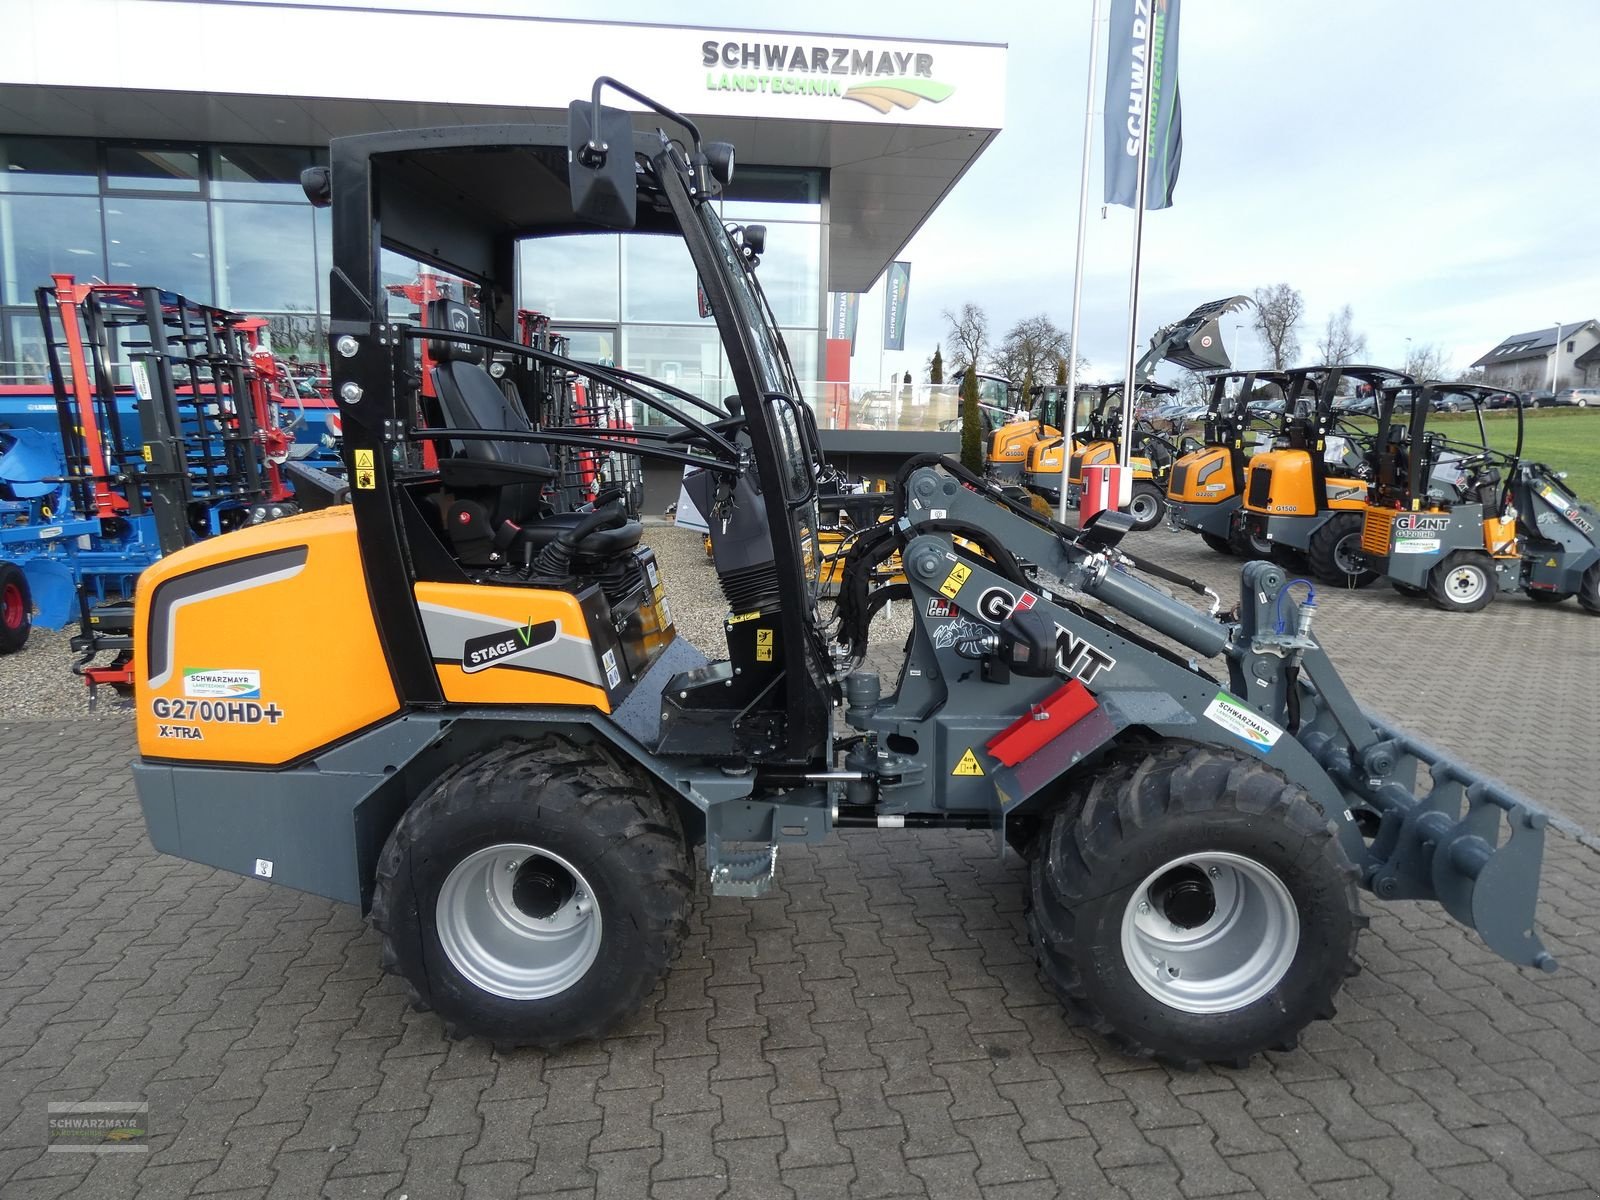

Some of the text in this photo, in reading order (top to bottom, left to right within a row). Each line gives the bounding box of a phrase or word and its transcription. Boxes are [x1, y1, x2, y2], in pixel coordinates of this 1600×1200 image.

[702, 41, 934, 77] SCHWARZMAYR
[706, 73, 842, 97] LANDTECHNIK
[1127, 0, 1151, 157] SCHWARZ
[1148, 14, 1166, 158] LANDTECHNIK
[890, 278, 899, 339] SCHWARZMAYR
[470, 639, 517, 663] STAGE
[977, 586, 1117, 685] GiNT
[191, 675, 249, 683] SCHWARZMAYR
[153, 698, 283, 724] G2700HD+
[1218, 701, 1271, 736] SCHWARZMAYR
[159, 725, 203, 739] X-TRA
